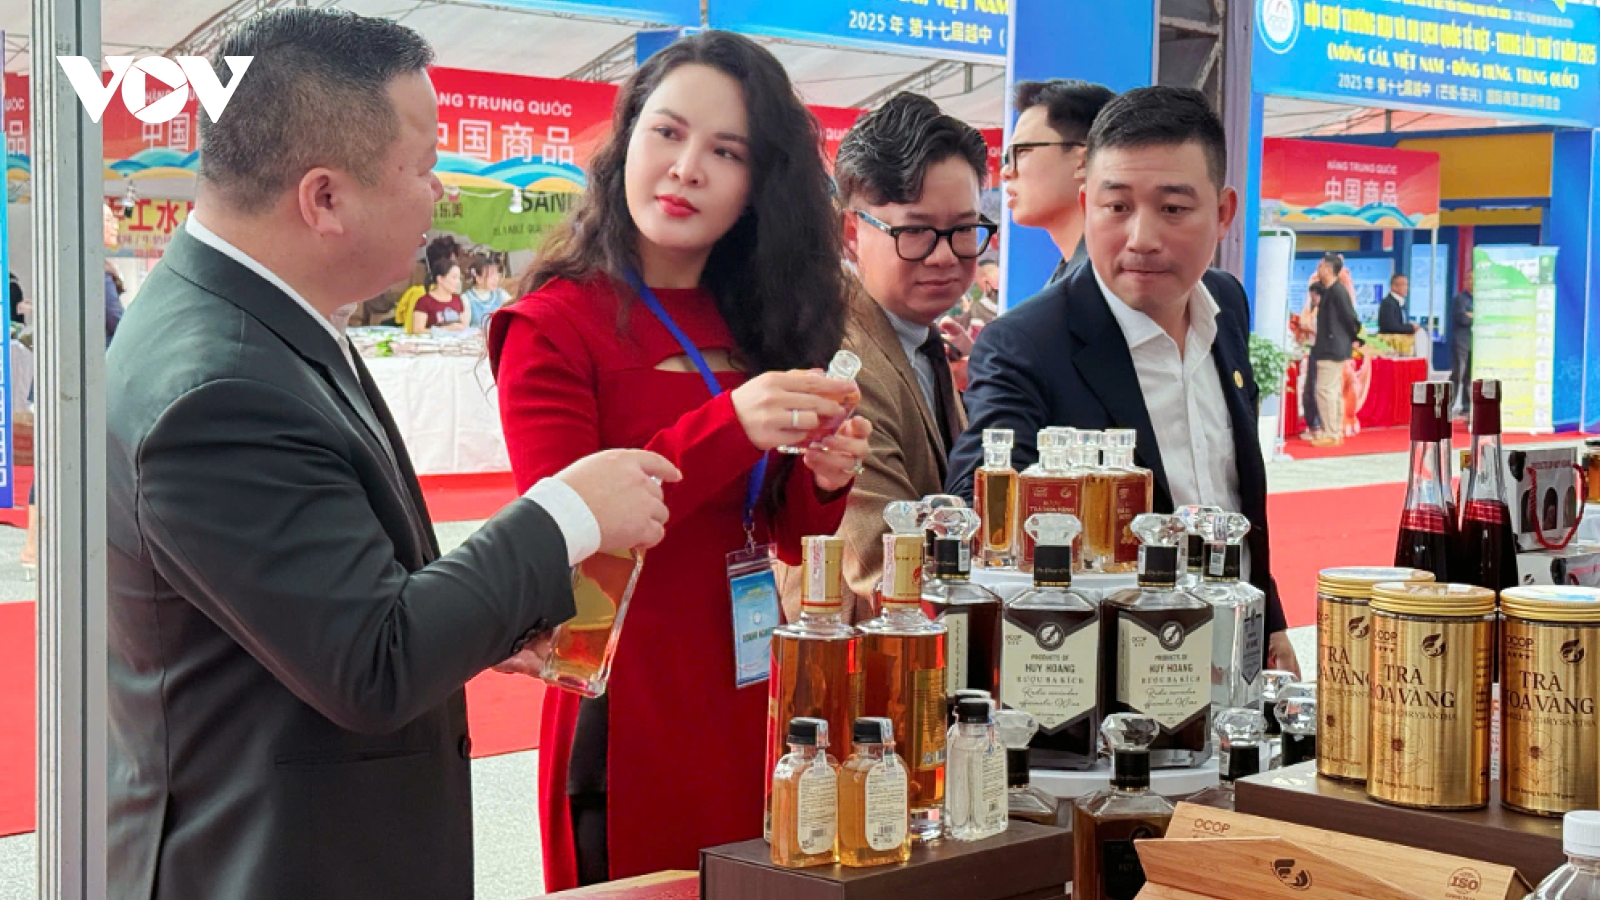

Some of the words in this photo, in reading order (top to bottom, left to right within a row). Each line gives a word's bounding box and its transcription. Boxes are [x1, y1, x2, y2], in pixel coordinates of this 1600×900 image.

[849, 10, 886, 32] 2025
[889, 15, 905, 37] 年
[1420, 56, 1444, 74] NAM
[468, 95, 524, 112] TRUNG
[528, 99, 572, 117] QUỐC
[1350, 162, 1375, 173] TRUNG
[1325, 176, 1398, 207] 中国商品
[1506, 635, 1534, 648] OCOP
[1025, 664, 1042, 673] HUY
[1046, 664, 1075, 673] HOANG
[1149, 664, 1164, 674] HUY
[1167, 664, 1193, 673] HOANG
[1384, 664, 1424, 685] TRÀ
[1519, 671, 1563, 692] TRÀ
[1399, 687, 1455, 708] VÀNG
[1535, 695, 1595, 715] VÀNG
[1194, 818, 1231, 833] OCOP
[1450, 876, 1479, 890] ISO
